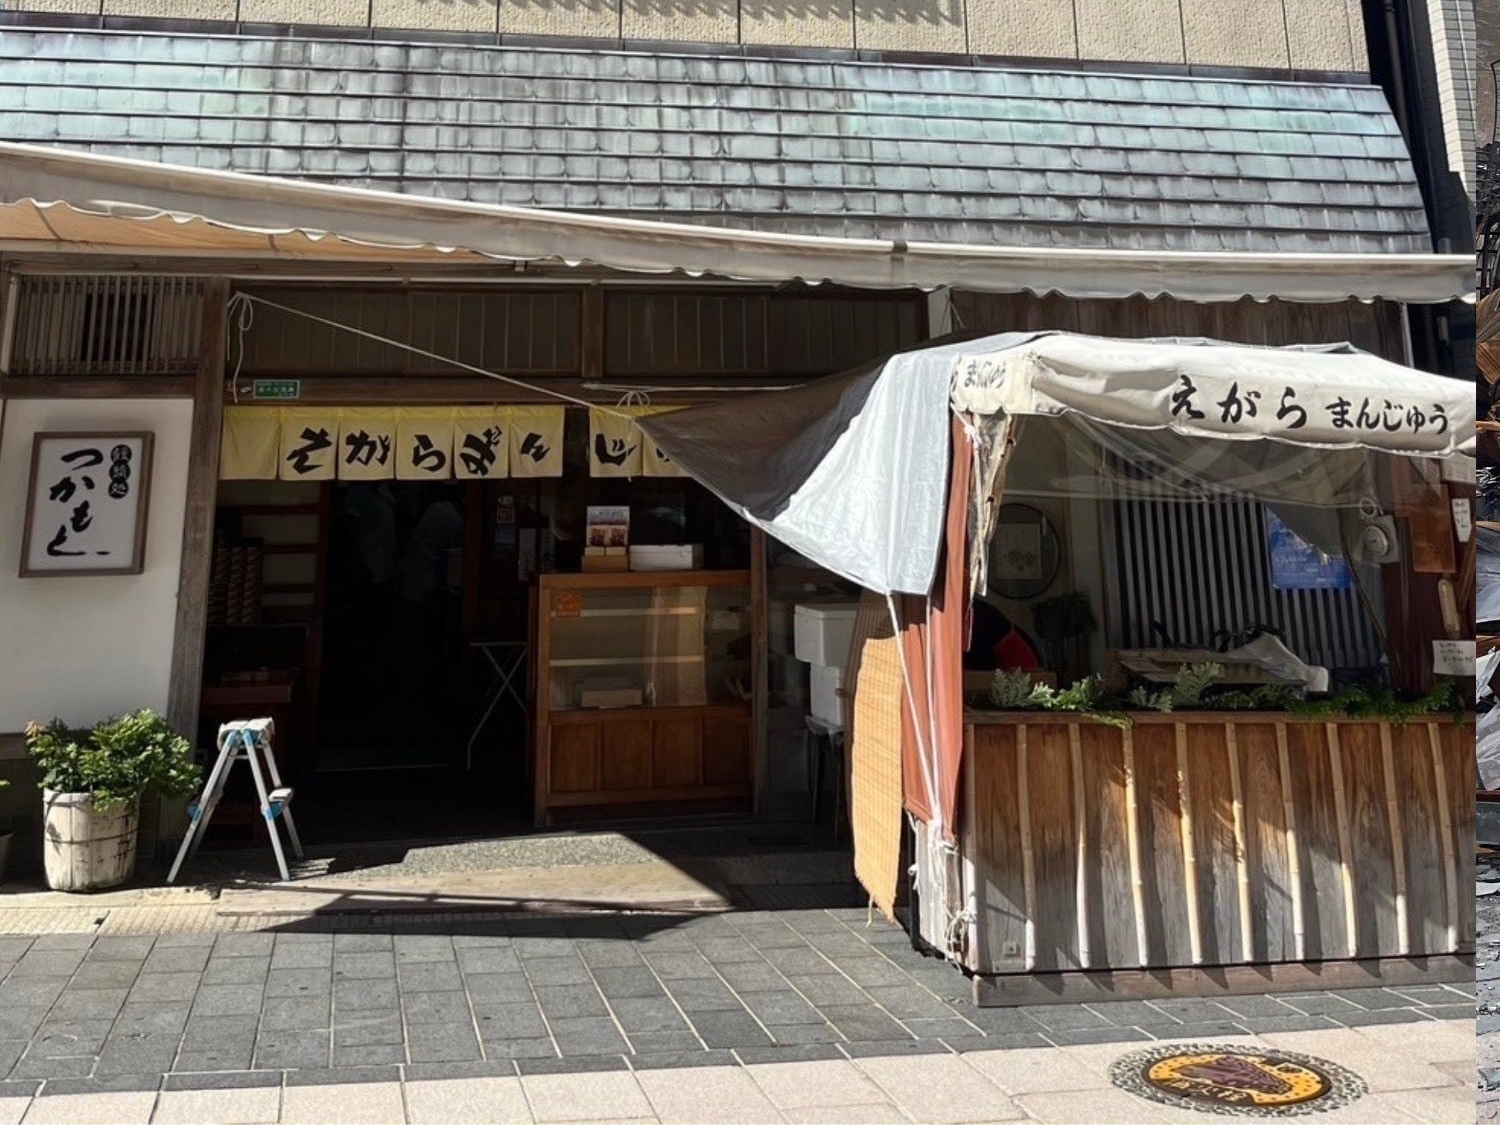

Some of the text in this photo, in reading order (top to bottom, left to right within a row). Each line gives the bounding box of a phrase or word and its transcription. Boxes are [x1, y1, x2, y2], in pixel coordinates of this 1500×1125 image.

[1171, 374, 1449, 435] えがら まんじゅう
[47, 448, 105, 557] つかもと
